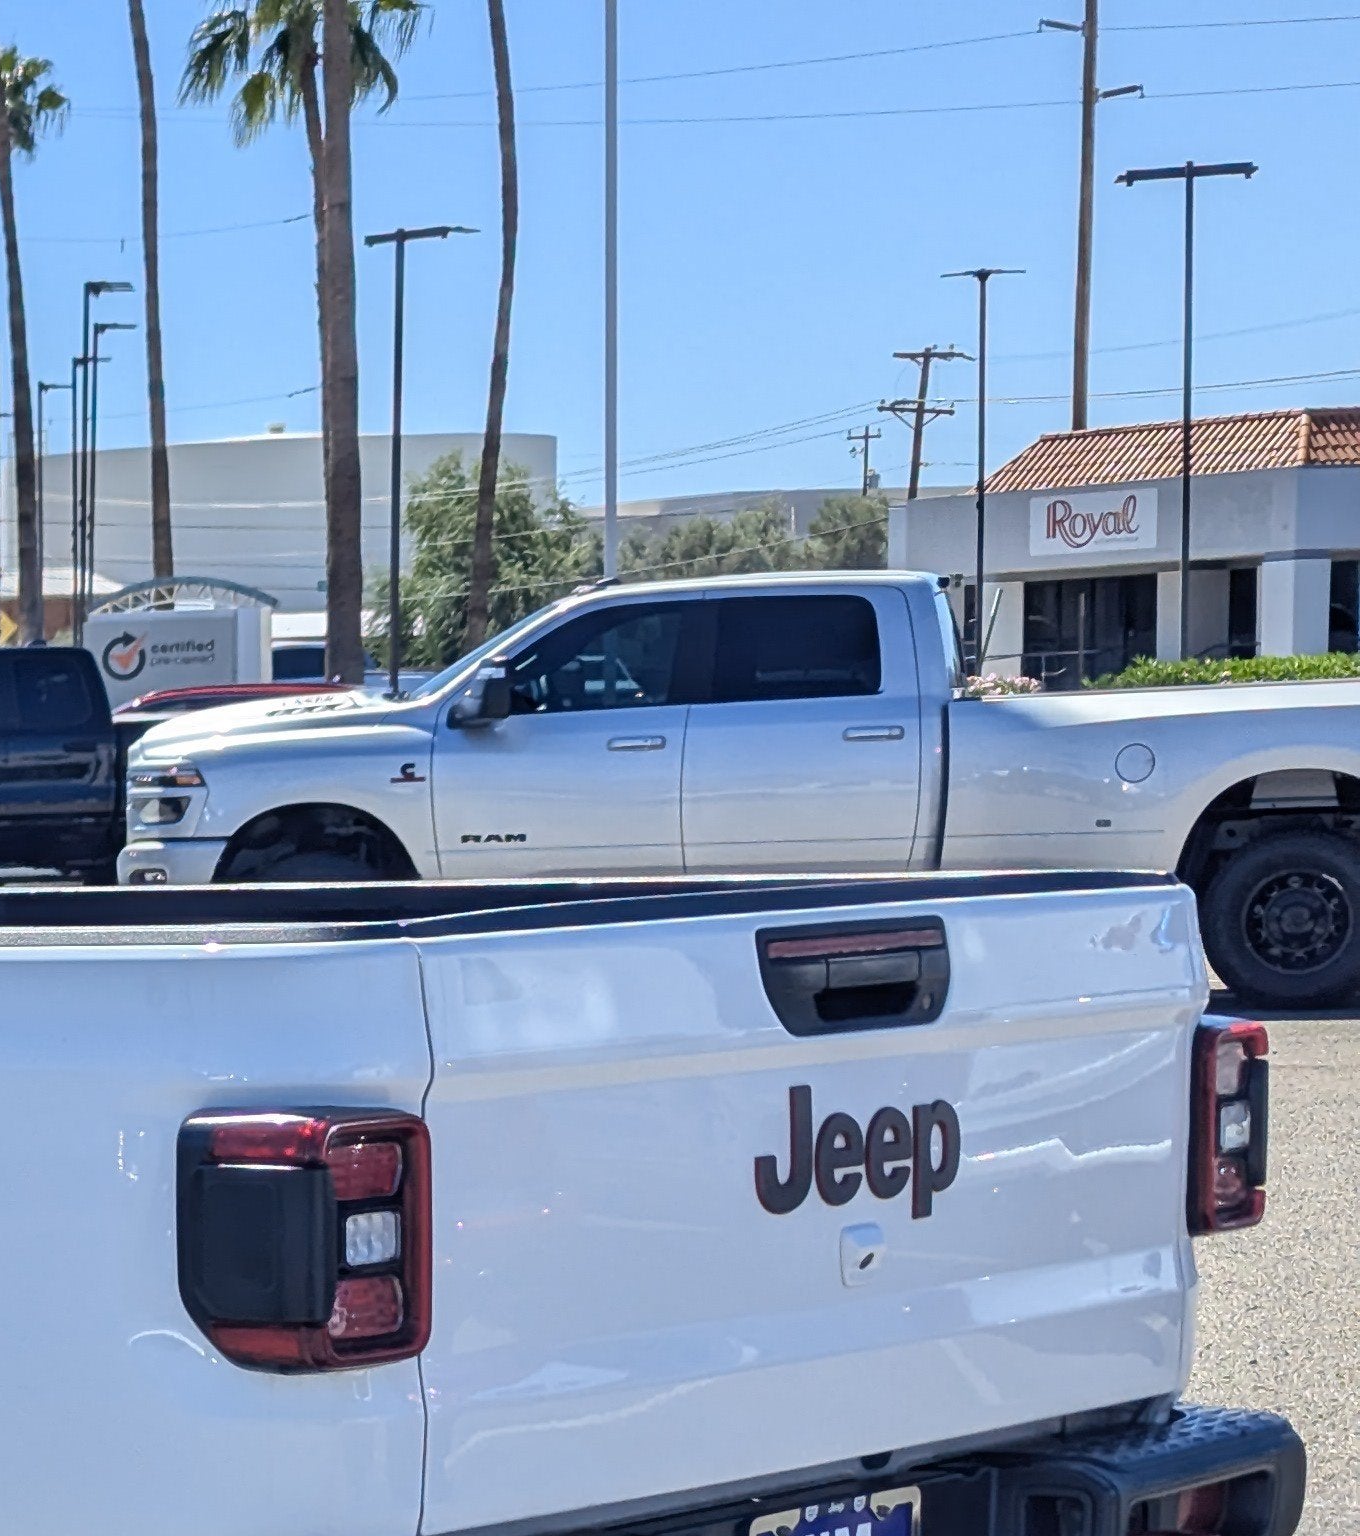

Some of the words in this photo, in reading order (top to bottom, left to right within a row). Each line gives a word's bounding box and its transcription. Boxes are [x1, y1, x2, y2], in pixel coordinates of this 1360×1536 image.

[1046, 494, 1140, 549] Royal
[150, 638, 216, 654] certified
[460, 833, 527, 844] RAM
[754, 1084, 961, 1220] Jeep
